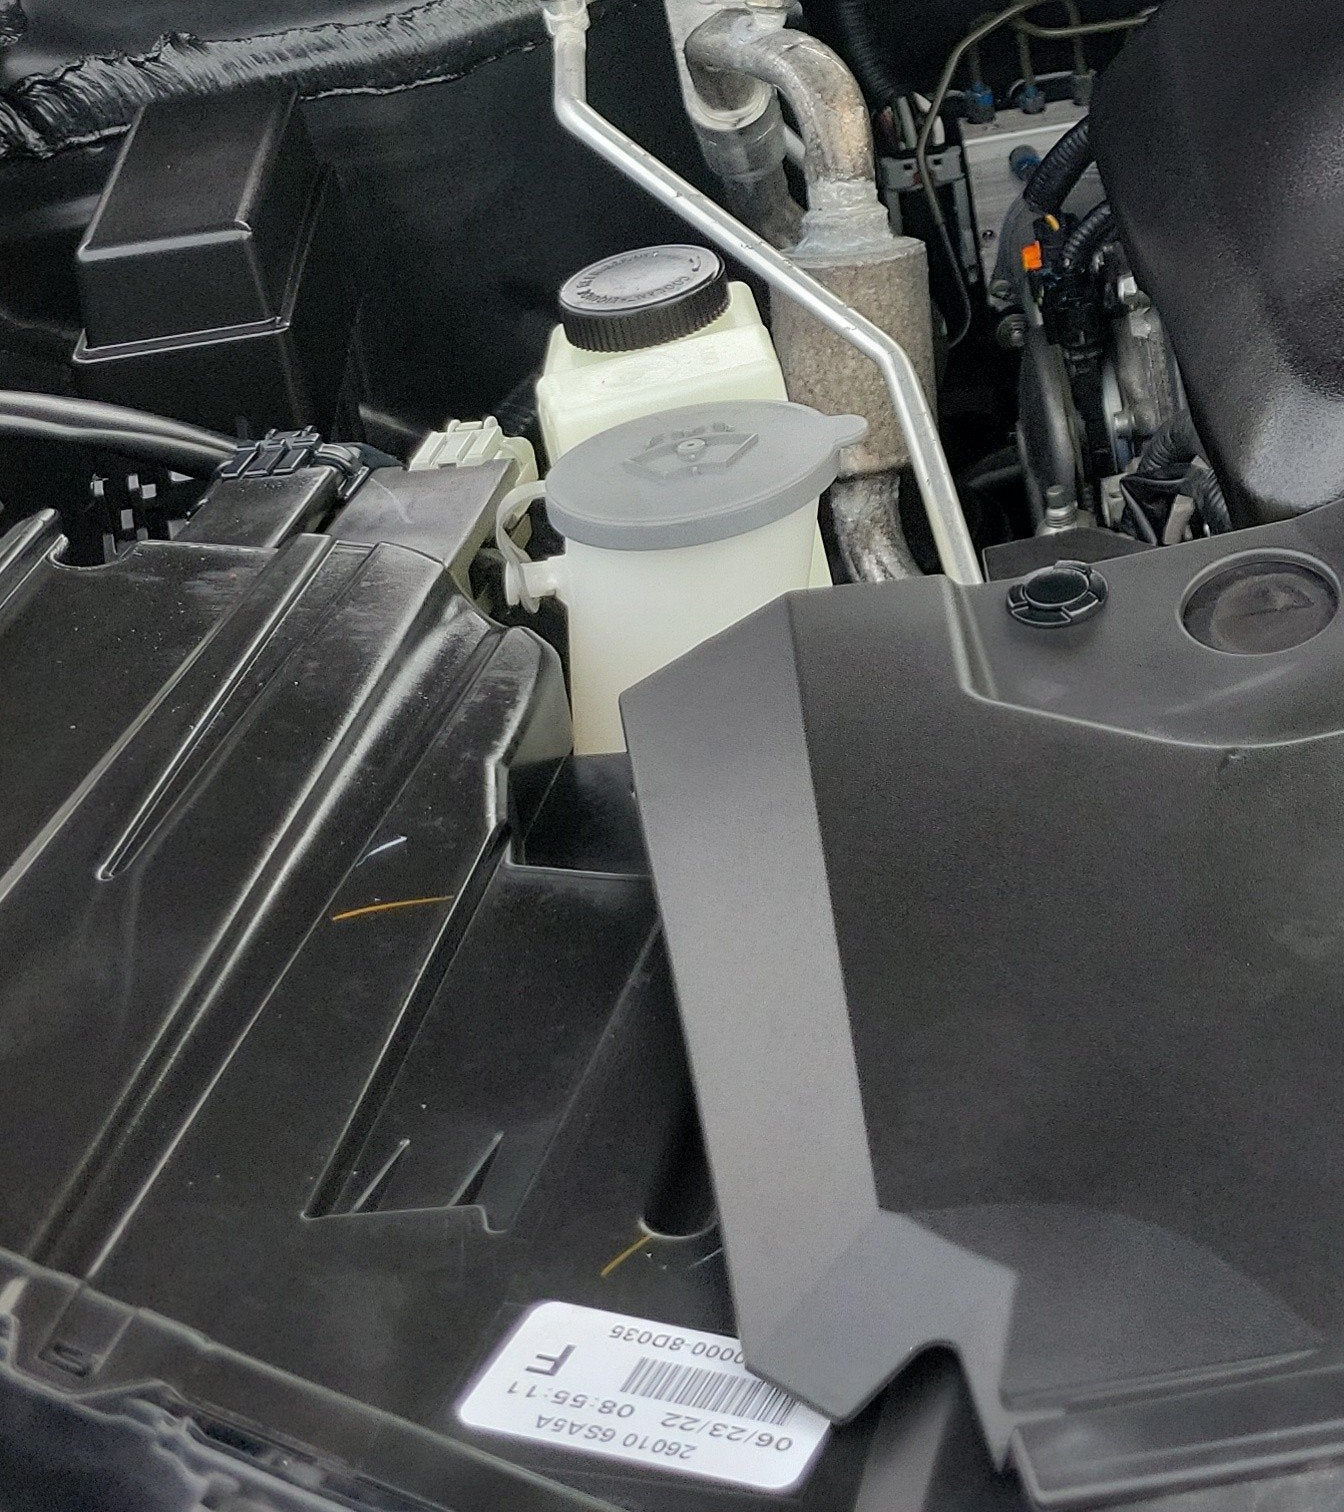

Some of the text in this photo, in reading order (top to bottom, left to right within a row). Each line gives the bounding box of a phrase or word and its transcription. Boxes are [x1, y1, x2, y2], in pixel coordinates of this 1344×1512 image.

[525, 1344, 577, 1377] F
[506, 1380, 793, 1452] 06/23/22 08:55:11
[535, 1415, 698, 1460] 26010 6SA5A
